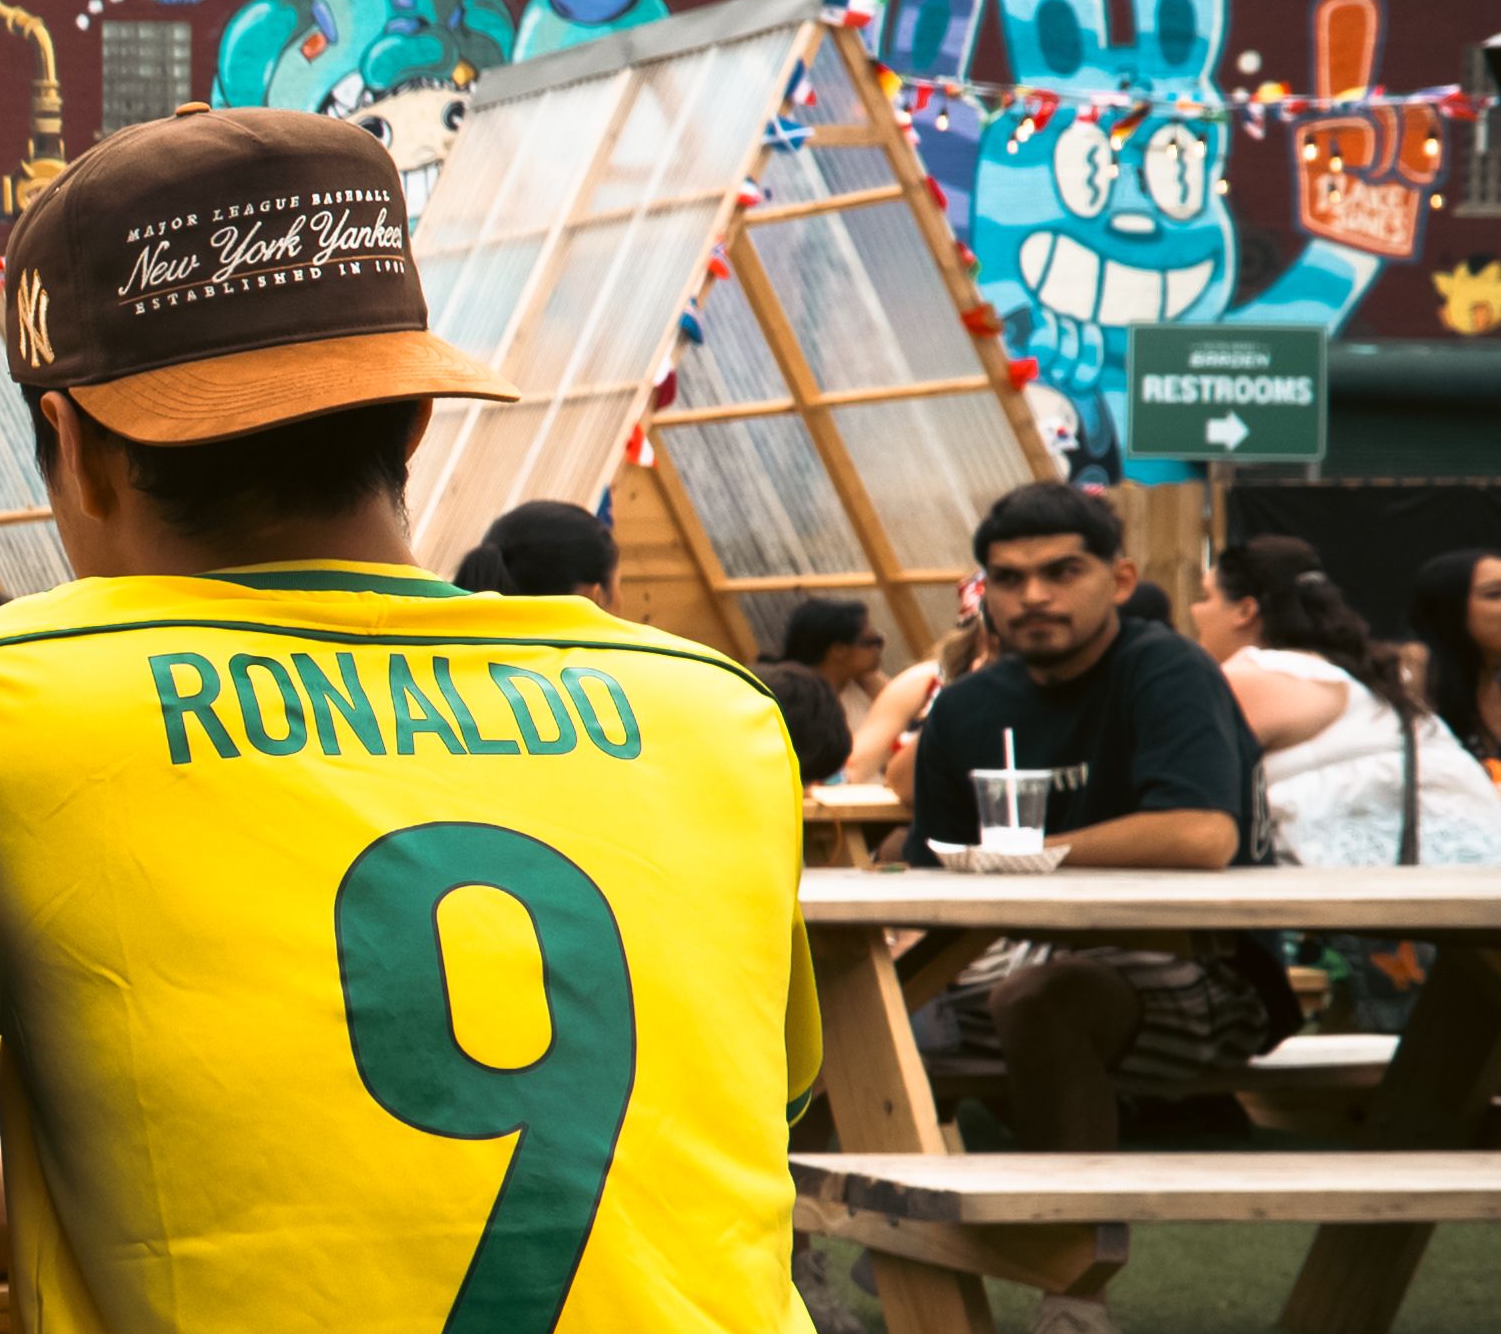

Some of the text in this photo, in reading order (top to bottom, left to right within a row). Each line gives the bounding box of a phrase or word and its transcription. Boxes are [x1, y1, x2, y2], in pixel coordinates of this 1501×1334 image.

[126, 189, 390, 243] MAJOR LEAGUE BASEBALL
[118, 240, 200, 296] New
[209, 214, 306, 283] York
[134, 266, 322, 315] ESTABLISHED
[338, 261, 361, 277] IN
[1142, 374, 1314, 405] RESTROOMS
[148, 652, 643, 765] RONALDO
